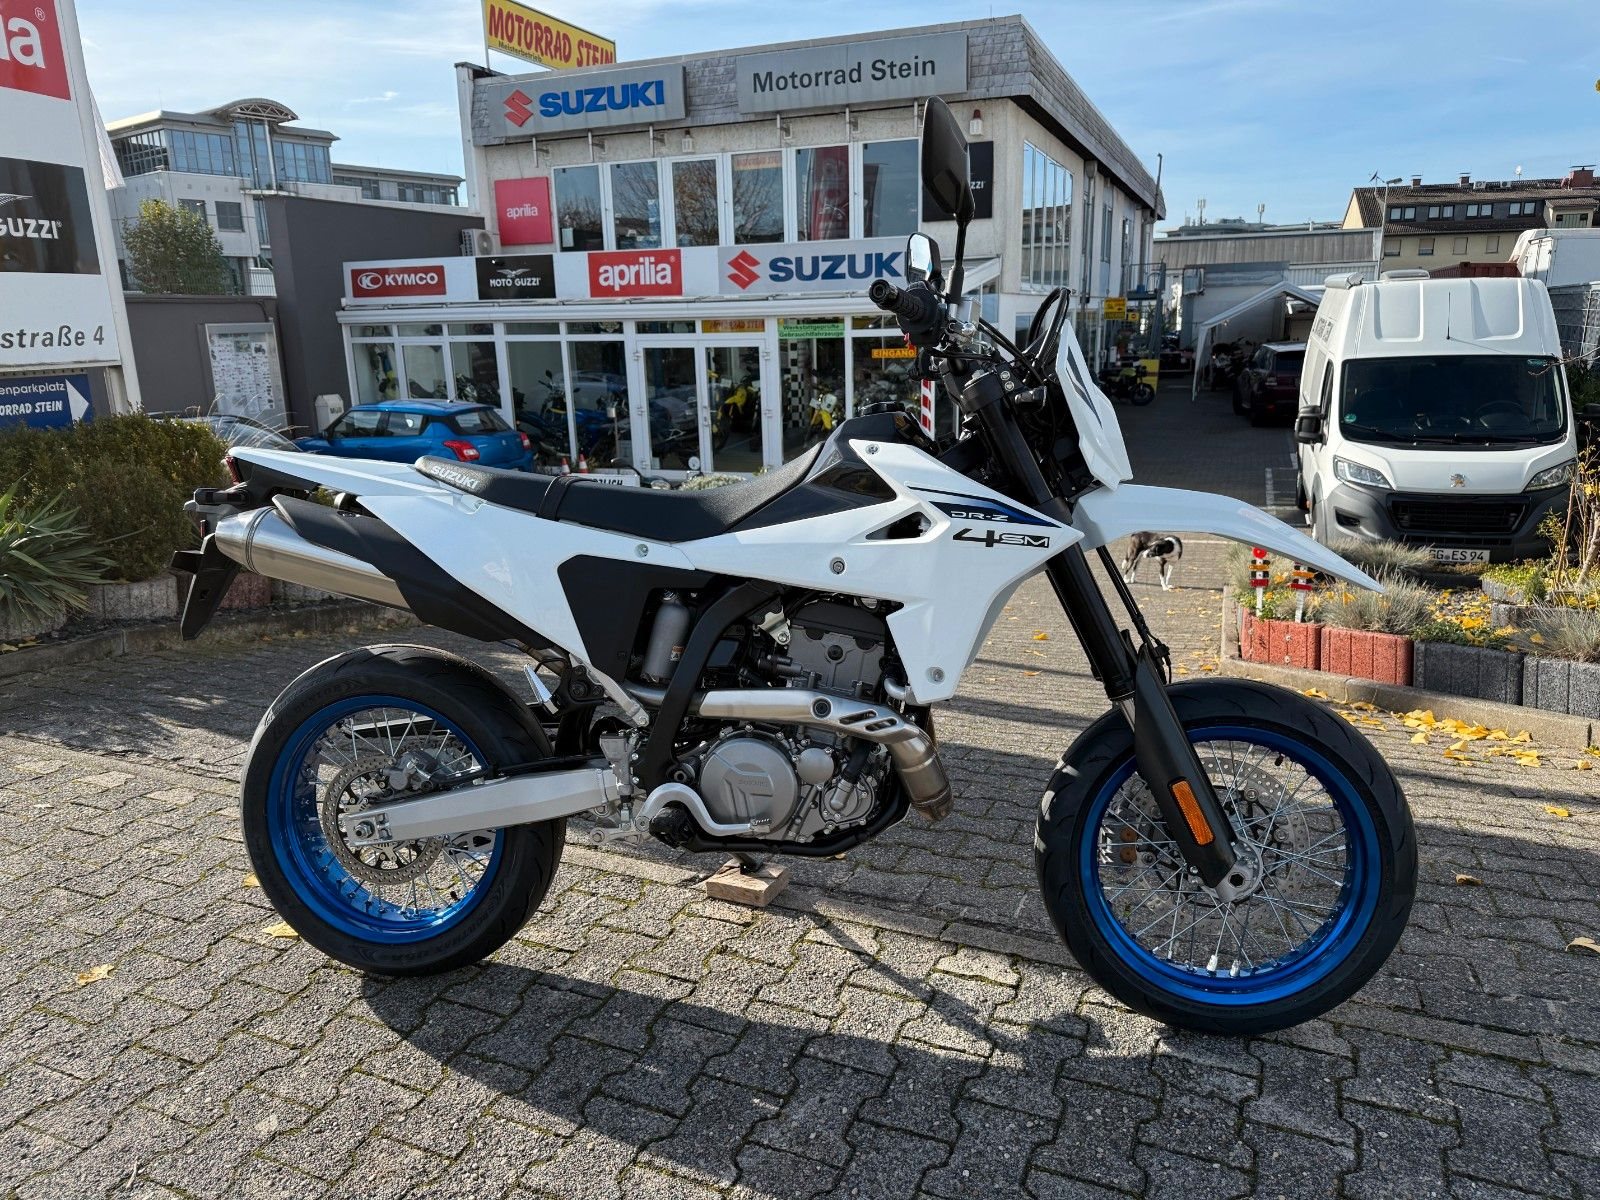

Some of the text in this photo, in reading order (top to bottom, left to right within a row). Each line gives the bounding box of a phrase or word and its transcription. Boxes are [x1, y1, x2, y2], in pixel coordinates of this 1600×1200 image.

[489, 3, 613, 68] MOTORRAD STEIN
[753, 55, 936, 94] Motorrad Stein
[539, 80, 665, 118] SUZUKI
[506, 203, 538, 220] aprilia
[385, 272, 439, 286] KYMCO
[598, 256, 673, 292] aprilia
[768, 251, 907, 283] SUZUK
[489, 278, 540, 288] MOTO GUZZI
[0, 324, 105, 349] straße 4
[34, 400, 63, 413] STEIN
[430, 465, 480, 490] SUZUKI
[950, 510, 1009, 522] DR-Z
[1451, 550, 1468, 561] ES
[1470, 551, 1484, 561] 94
